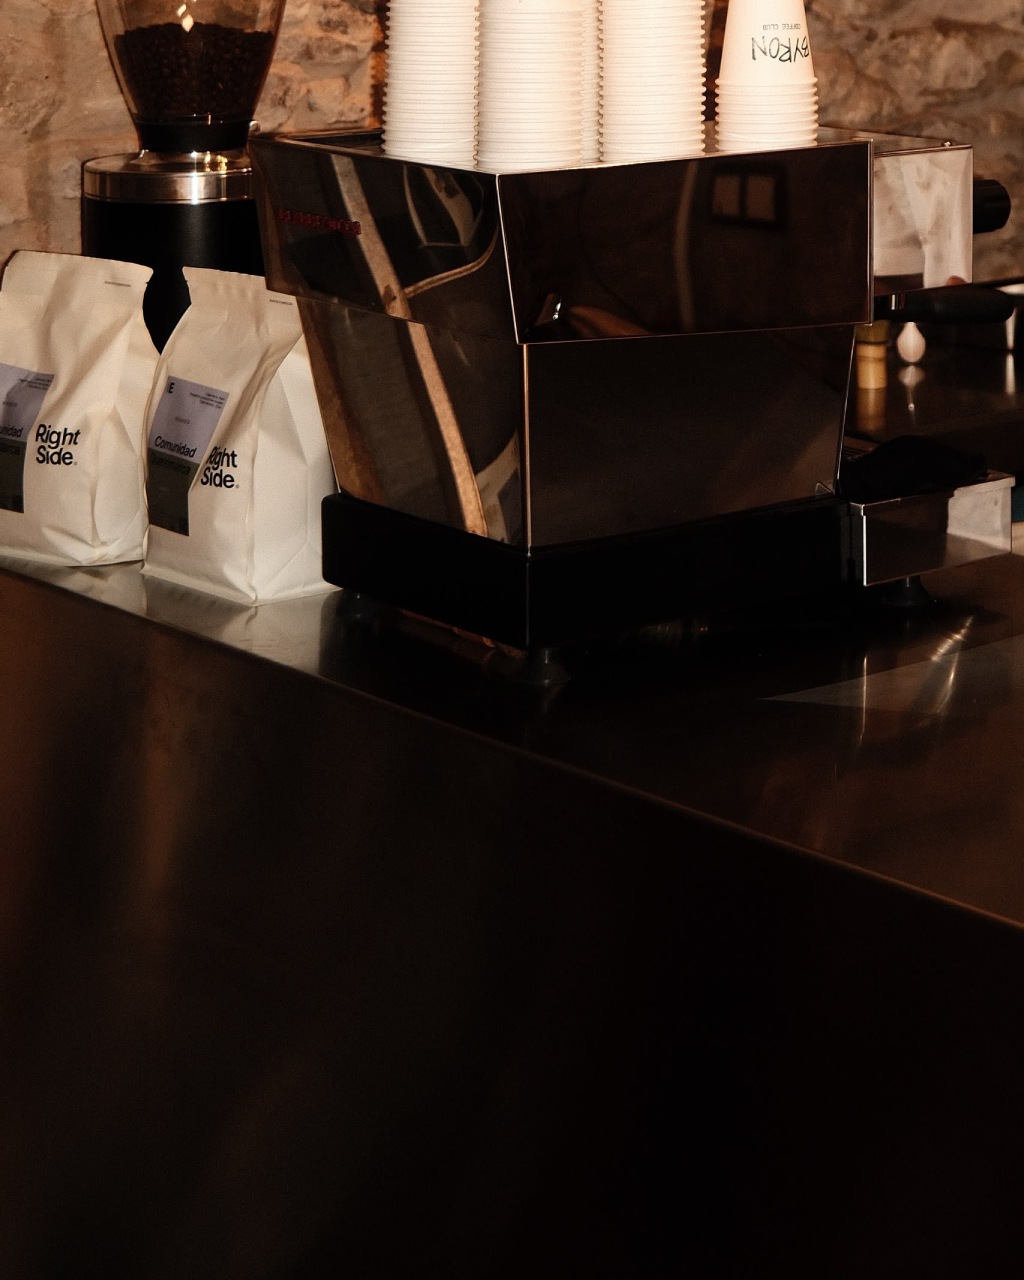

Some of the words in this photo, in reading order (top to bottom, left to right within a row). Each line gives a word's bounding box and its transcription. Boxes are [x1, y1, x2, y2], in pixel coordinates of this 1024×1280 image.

[762, 23, 779, 31] CLUB
[751, 35, 810, 63] BYRON
[35, 423, 81, 449] Right
[154, 435, 198, 458] Comunidad
[36, 444, 74, 466] Side
[200, 466, 235, 489] Side
